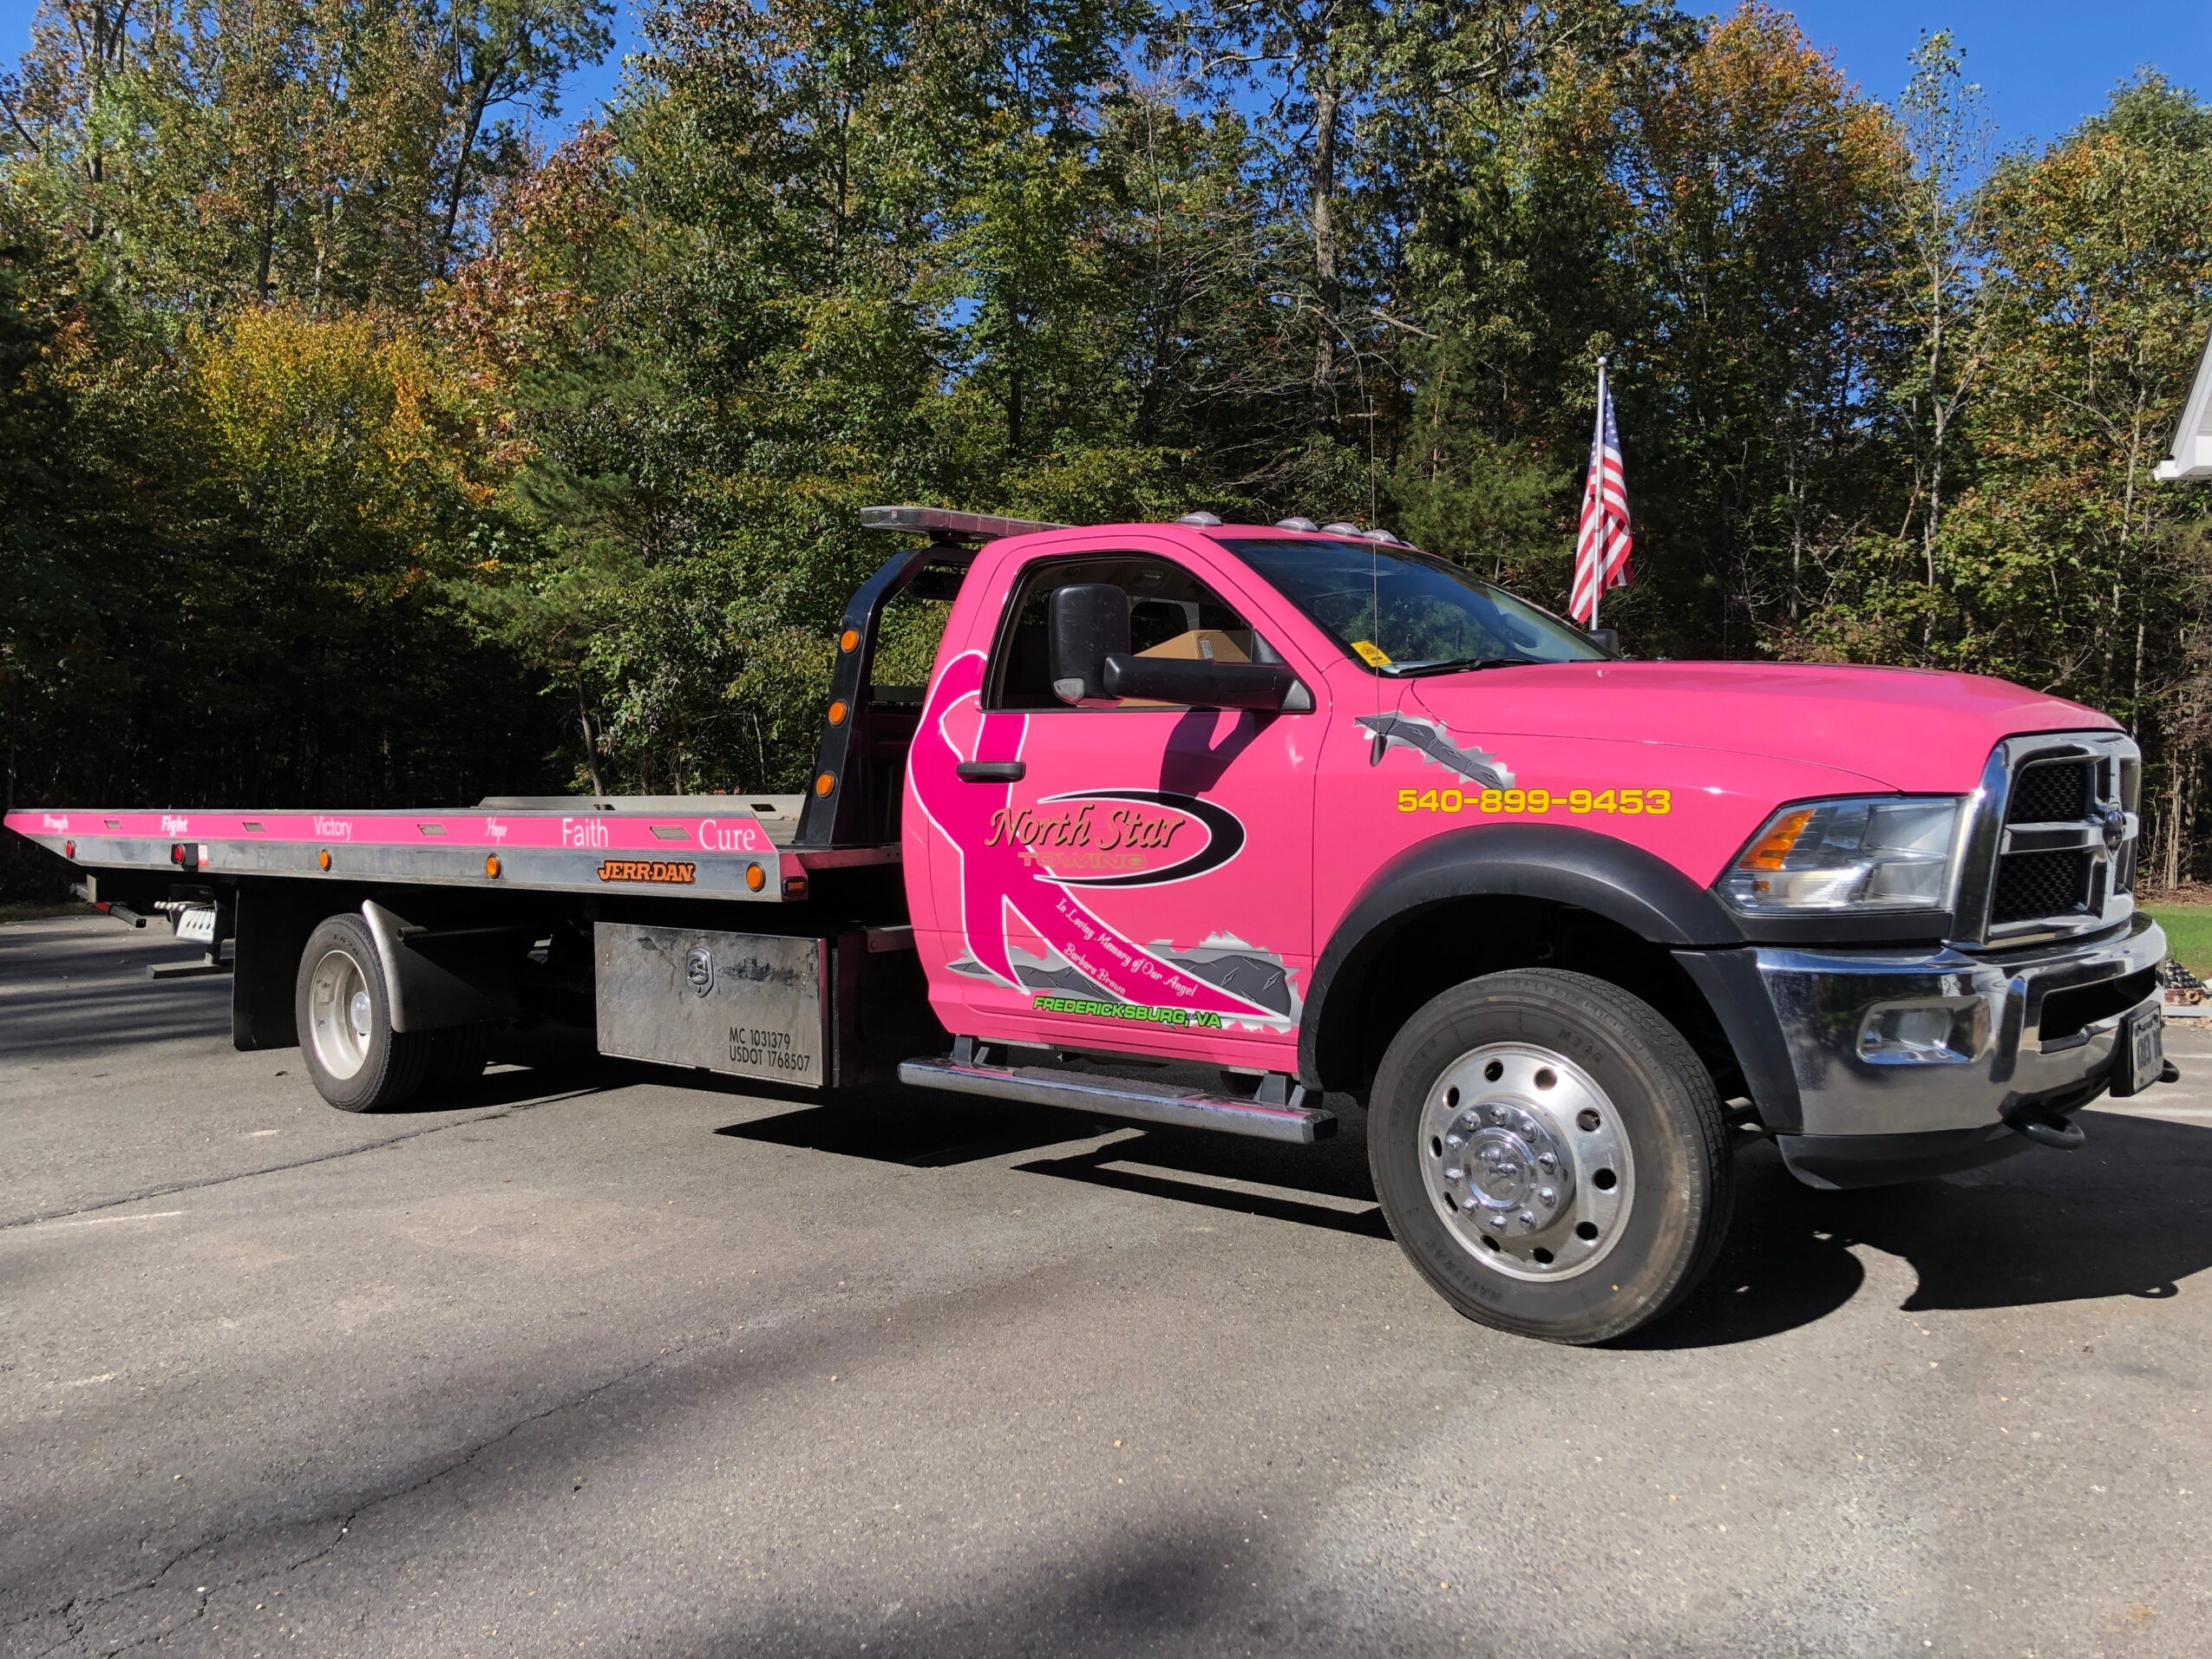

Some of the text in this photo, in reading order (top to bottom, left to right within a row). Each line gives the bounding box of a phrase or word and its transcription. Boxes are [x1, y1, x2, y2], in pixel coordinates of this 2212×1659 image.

[1397, 788, 1672, 815] 540-899-9453
[161, 815, 189, 837] Fight
[314, 816, 352, 842] Victory
[484, 817, 507, 846] Hope
[563, 818, 609, 847] Faith
[699, 820, 756, 851] Cure
[984, 802, 1186, 851] North Star
[1018, 852, 1149, 870] TOWING
[1056, 898, 1199, 997] In Loving Memory of Our Angel
[1063, 942, 1127, 996] Barbara Brown
[1032, 996, 1222, 1029] FREDERICKSBURG, VA
[729, 1027, 791, 1050] MC 1031379
[730, 1045, 810, 1072] USDOT 1768507
